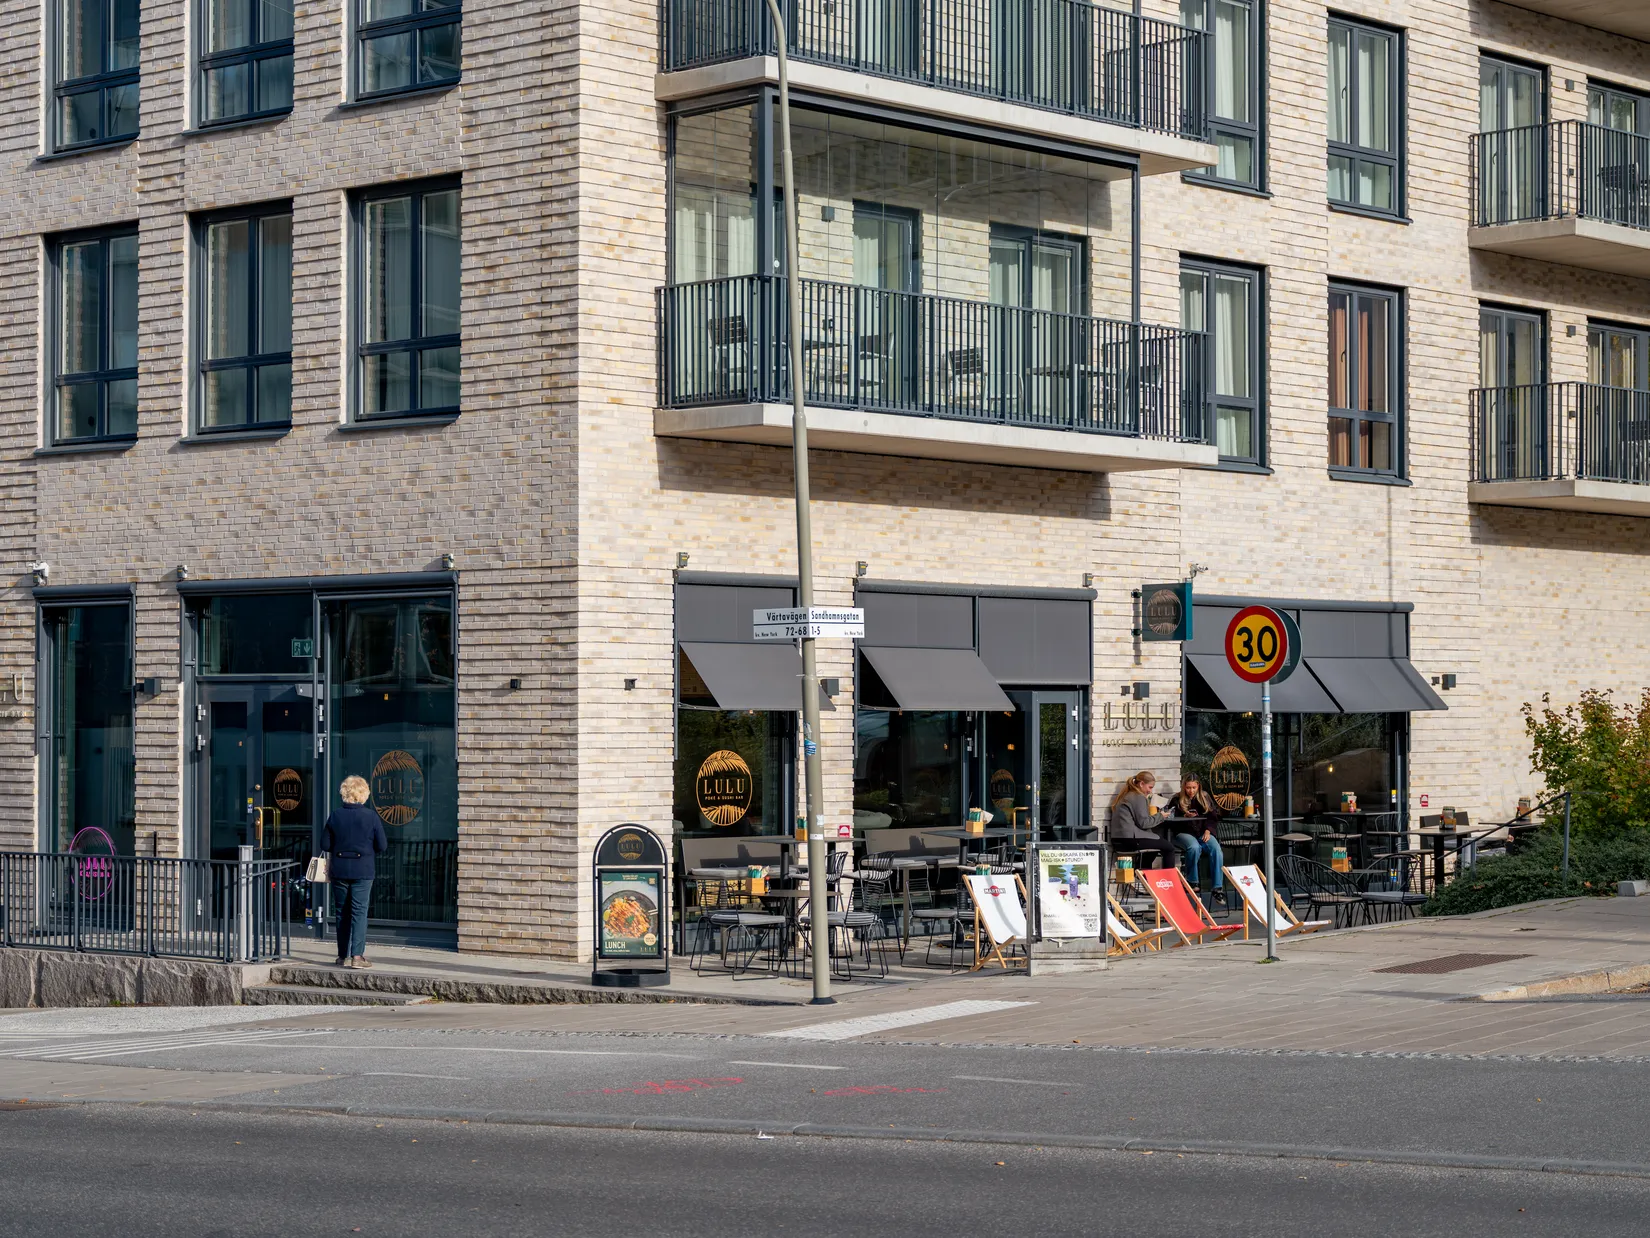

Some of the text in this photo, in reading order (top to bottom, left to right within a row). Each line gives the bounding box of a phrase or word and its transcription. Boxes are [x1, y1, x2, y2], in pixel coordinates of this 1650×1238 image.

[766, 611, 807, 623] Värtavägen
[811, 610, 860, 622] Sandhamnsgatan
[1150, 606, 1177, 616] LULU
[785, 626, 807, 636] 72-68
[811, 626, 821, 635] 1-5
[1236, 625, 1278, 663] 30
[1103, 702, 1176, 731] LULU
[1214, 770, 1245, 784] LULU
[277, 783, 298, 793] LULU
[377, 779, 416, 794] LULU
[704, 778, 745, 795] LULU
[604, 941, 626, 949] LUNCH
